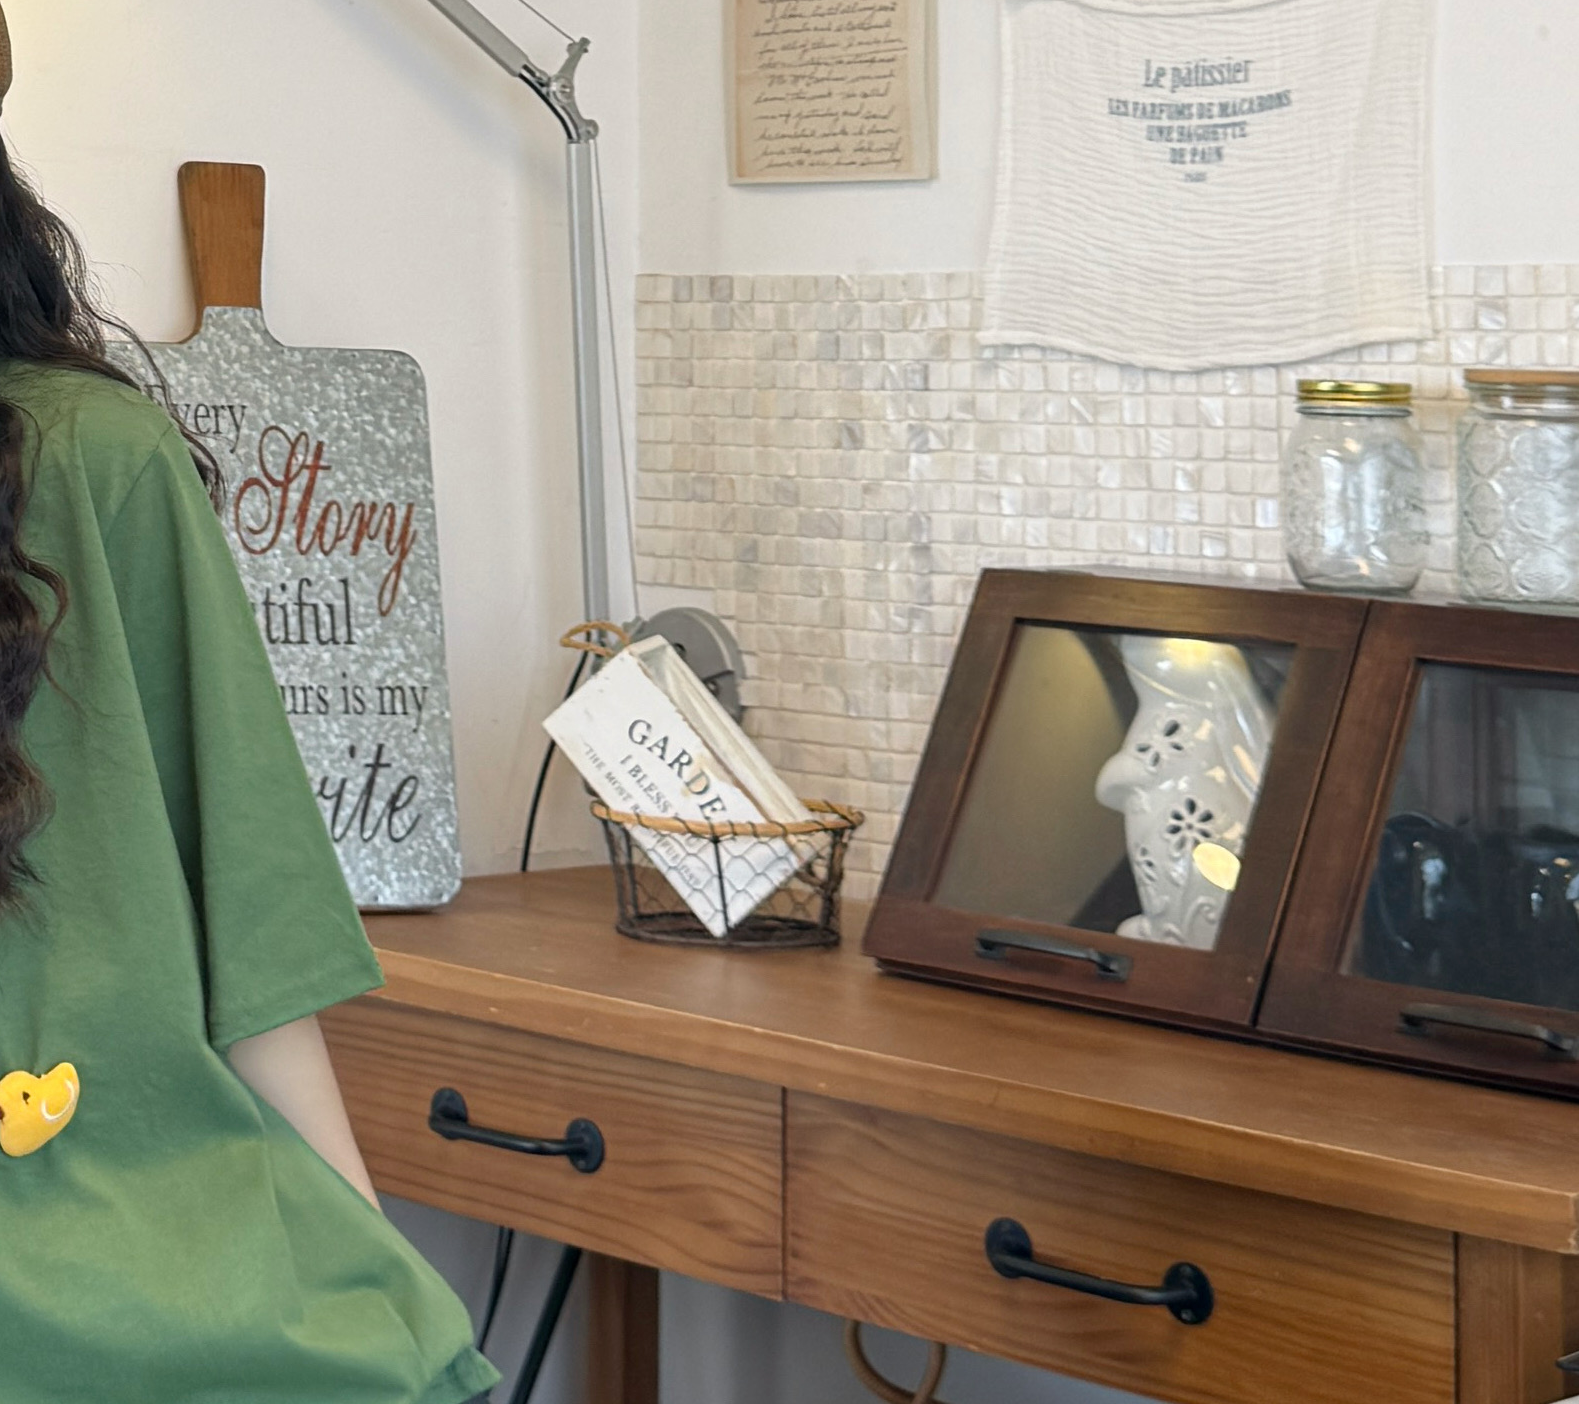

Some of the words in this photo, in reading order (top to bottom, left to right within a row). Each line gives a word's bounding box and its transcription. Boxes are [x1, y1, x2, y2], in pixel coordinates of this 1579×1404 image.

[1142, 58, 1167, 88] Le
[1196, 102, 1214, 119] DE
[1218, 89, 1292, 118] MACARONS
[1170, 147, 1187, 164] DE
[171, 403, 247, 454] very
[234, 425, 416, 617] Story
[254, 577, 358, 646] tiful
[280, 684, 330, 716] urs
[341, 671, 367, 716] is
[377, 683, 429, 733] my
[316, 742, 422, 843] rite
[628, 719, 728, 821] GARDE
[628, 764, 672, 813] BLESS
